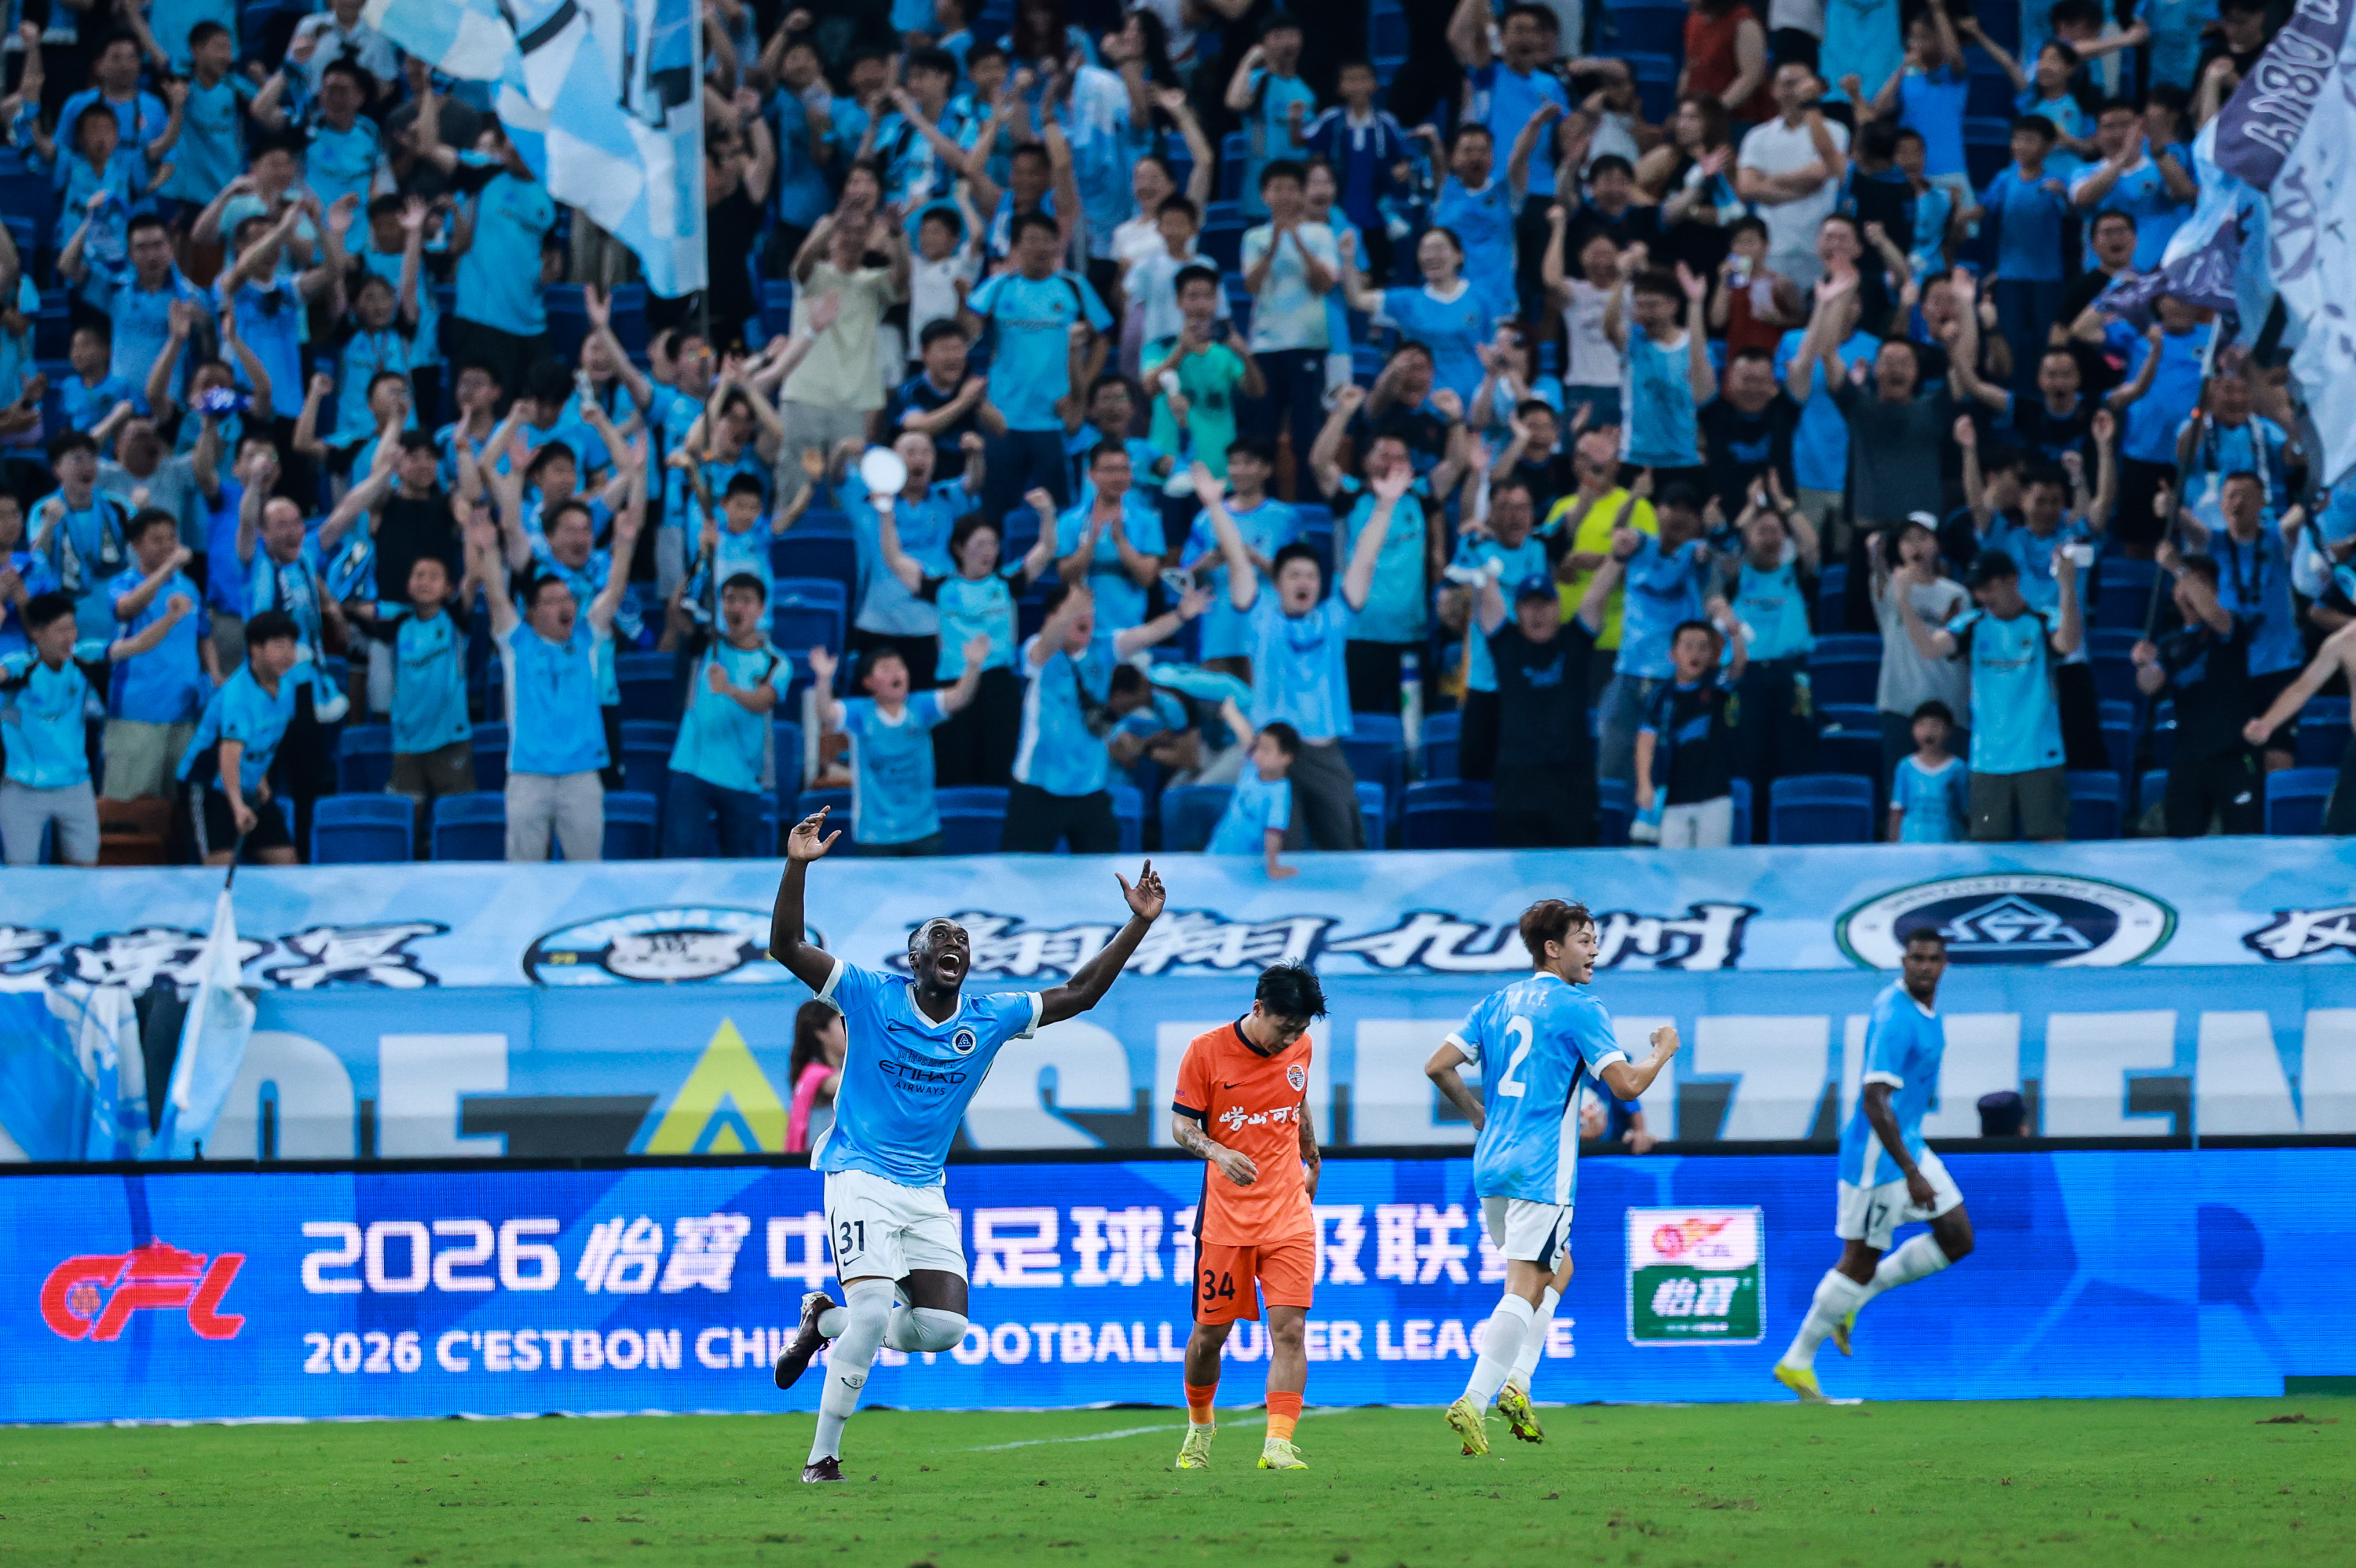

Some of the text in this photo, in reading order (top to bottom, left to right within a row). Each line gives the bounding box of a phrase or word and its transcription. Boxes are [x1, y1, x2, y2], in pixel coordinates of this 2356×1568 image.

[878, 1059, 967, 1084] ETIHAD
[1498, 1014, 1534, 1098] 2
[894, 1080, 946, 1096] AIRWAYS
[301, 1218, 561, 1293] 2026
[766, 1203, 1573, 1292] 中足球级联
[839, 1220, 865, 1255] 31
[1202, 1269, 1235, 1301] 34
[303, 1331, 423, 1374] 2026
[436, 1329, 682, 1372] C'ESTBON
[920, 1321, 1185, 1365] OOTBALL
[1376, 1318, 1575, 1361] LEAE
